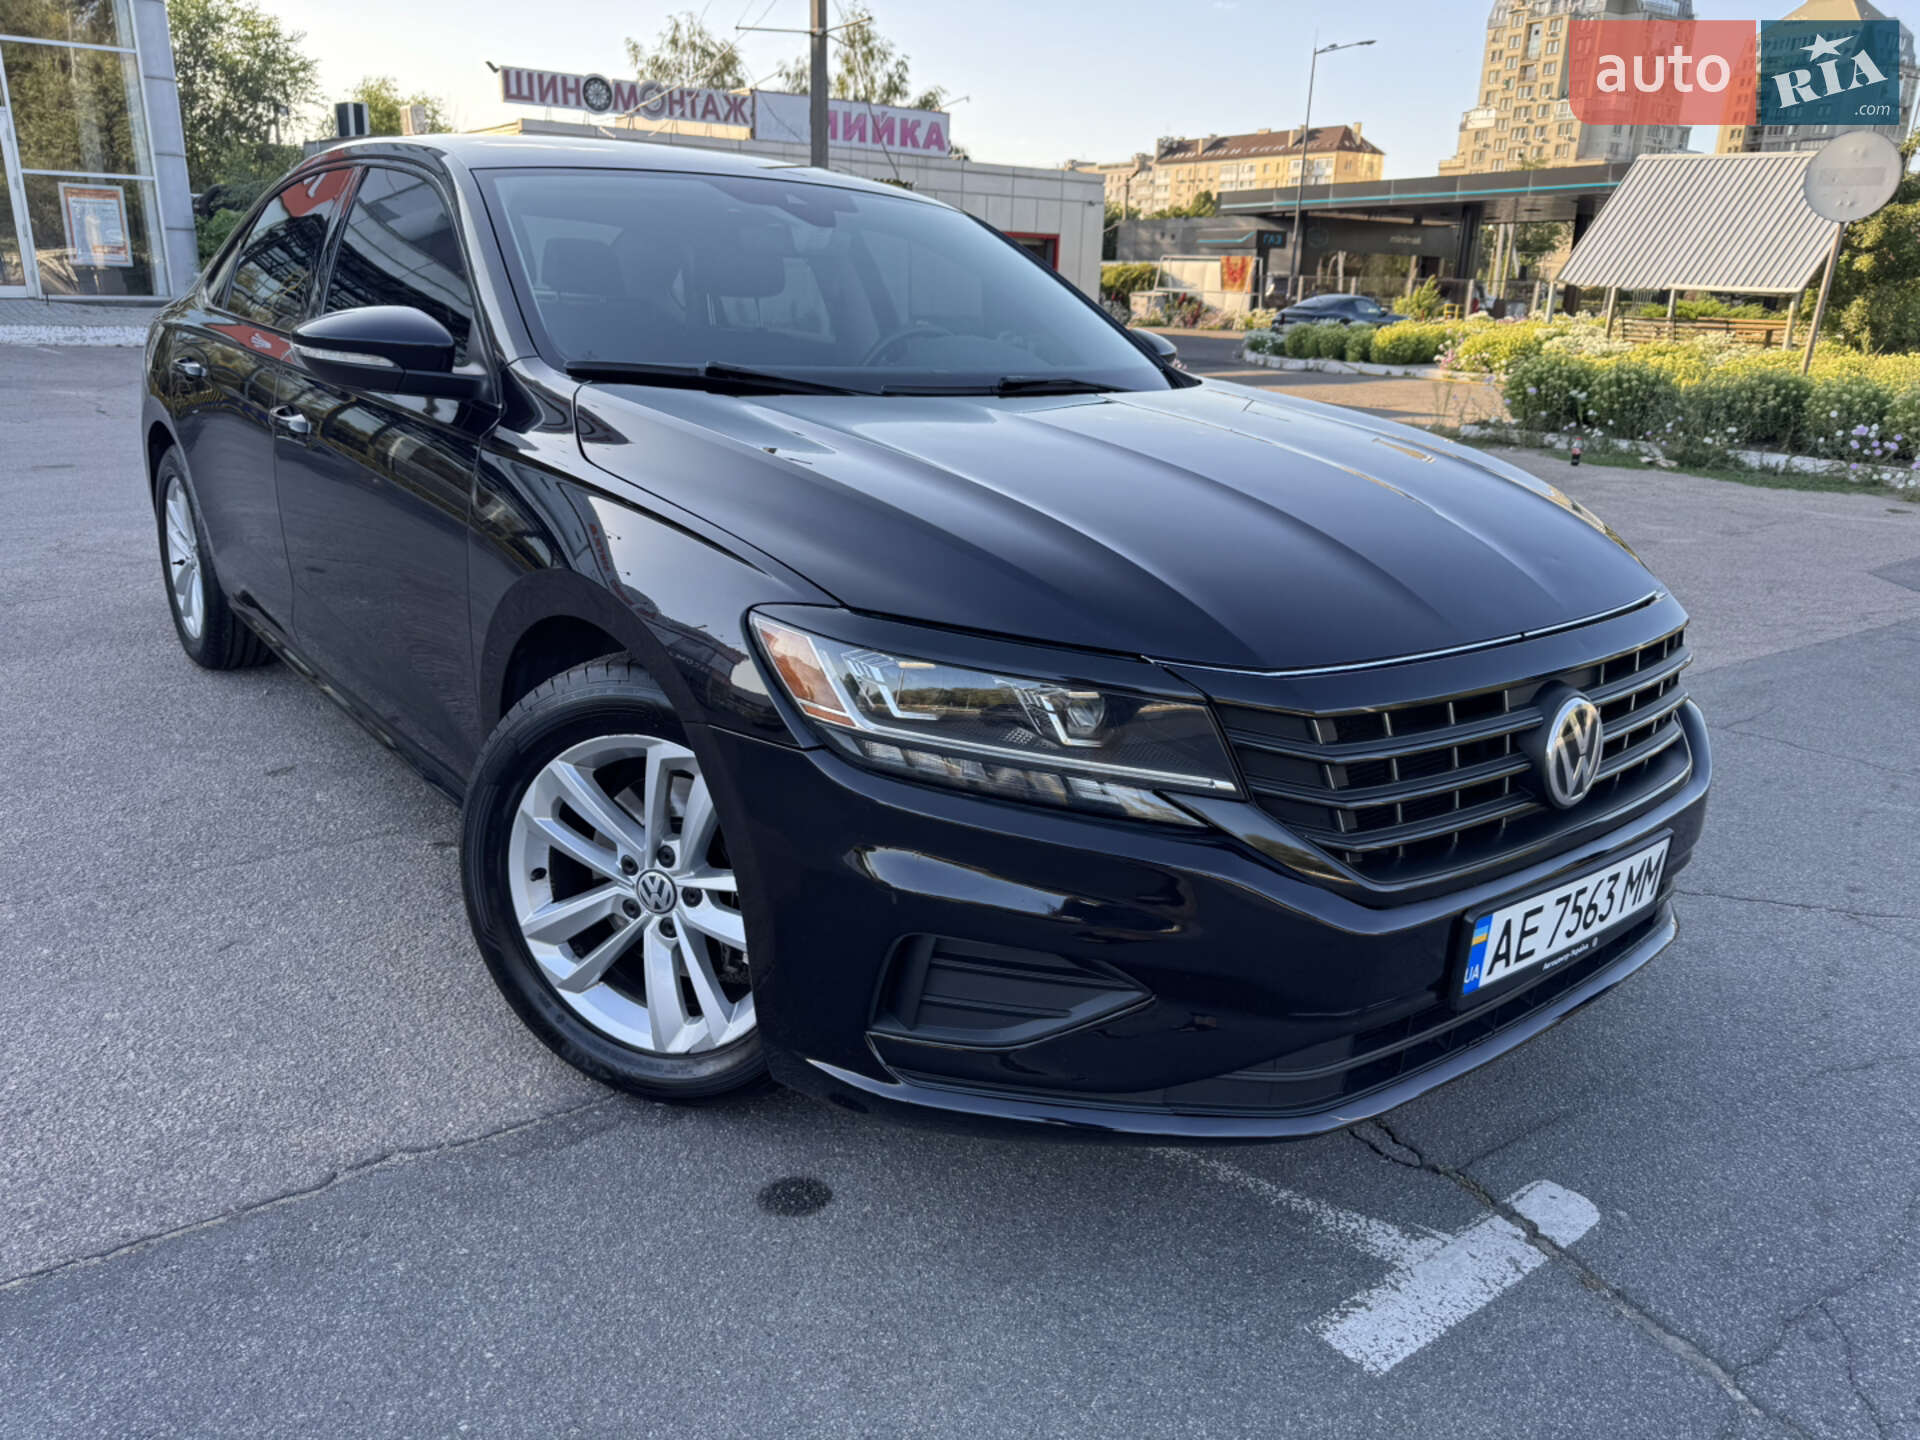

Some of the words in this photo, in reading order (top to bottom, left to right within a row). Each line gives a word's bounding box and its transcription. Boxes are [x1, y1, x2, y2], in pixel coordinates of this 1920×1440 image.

[502, 68, 750, 125] ШИНОМОНТАЖ
[1486, 904, 1545, 977] AE
[1546, 871, 1621, 949] 7563
[1619, 847, 1666, 914] MM
[1463, 965, 1480, 984] UA
